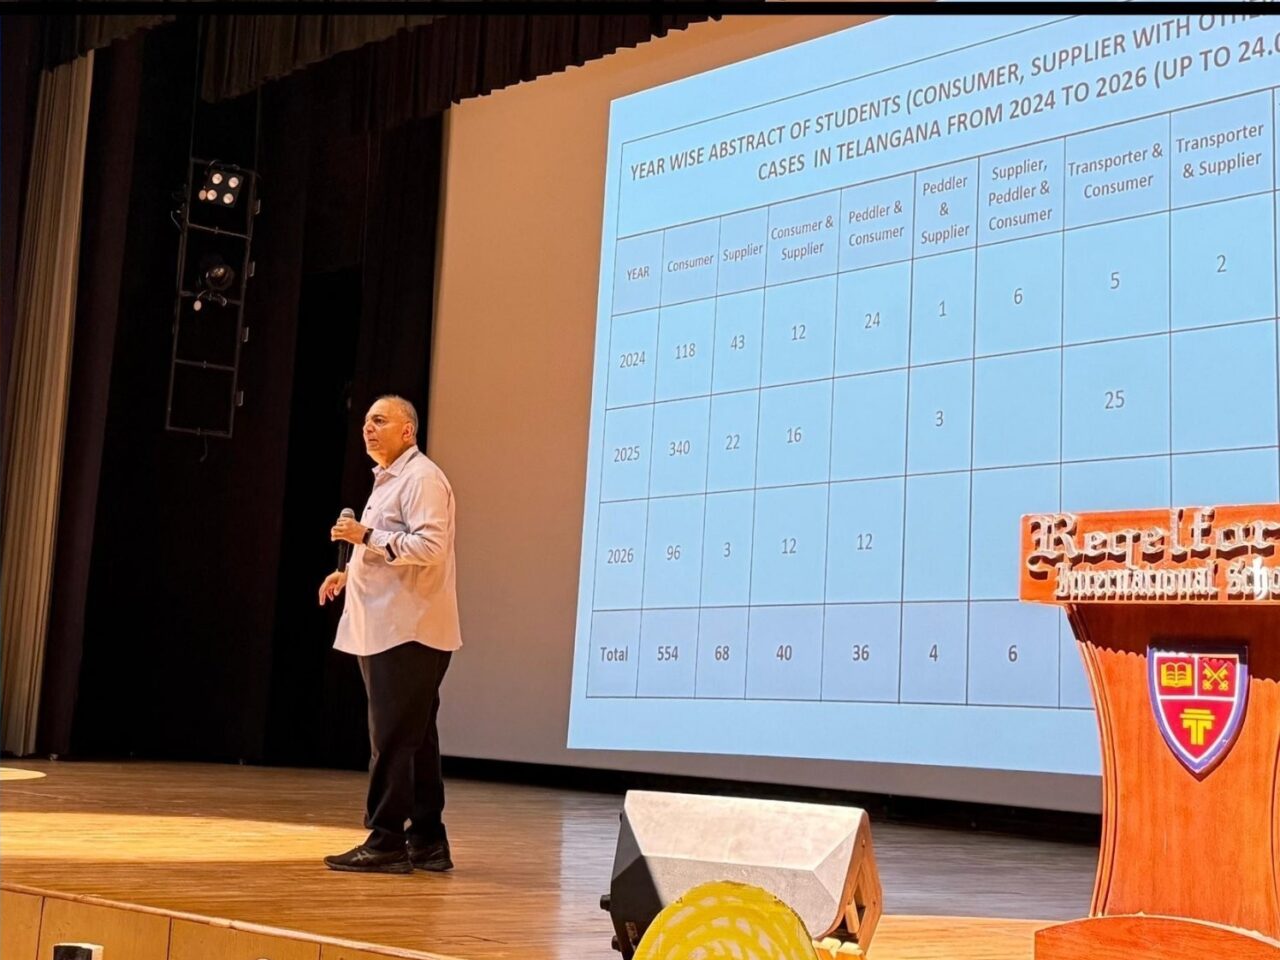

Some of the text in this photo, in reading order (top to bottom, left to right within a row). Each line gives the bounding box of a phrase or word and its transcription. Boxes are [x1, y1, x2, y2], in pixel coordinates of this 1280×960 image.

[630, 157, 665, 181] YEAR
[669, 146, 704, 171] WISE
[708, 125, 786, 162] ABSTRACT
[790, 119, 811, 140] OF
[814, 95, 901, 134] STUDENTS
[906, 63, 1024, 114] (CONSUMER,
[1031, 34, 1125, 77] SUPPLIER
[1132, 16, 1190, 49] WITH
[758, 46, 1231, 180] CASES IN TELANGANA FROM 2024 TO 2026 (UP TO
[1176, 125, 1264, 155] Transporter
[992, 159, 1047, 180] Supplier,
[1068, 143, 1163, 176] Transporter &
[1183, 152, 1262, 178] & Supplier
[923, 176, 967, 196] Peddler
[989, 186, 1036, 206] Peddler
[1084, 175, 1153, 198] Consumer
[849, 205, 890, 224] Peddler
[989, 209, 1052, 230] Consumer
[771, 221, 822, 240] Consumer
[849, 227, 904, 246] Consumer
[921, 224, 969, 244] Supplier
[627, 243, 763, 280] YEAR Consumer Supplier
[782, 242, 824, 261] Supplier
[620, 255, 1226, 368] 2024 118 43 12 24 1 6 5 2
[614, 390, 1124, 462] 2025 340 22 16 3 25
[608, 534, 872, 564] 2026 96 3 12 12
[601, 645, 1017, 662] Total 554 68 40 36 4 6
